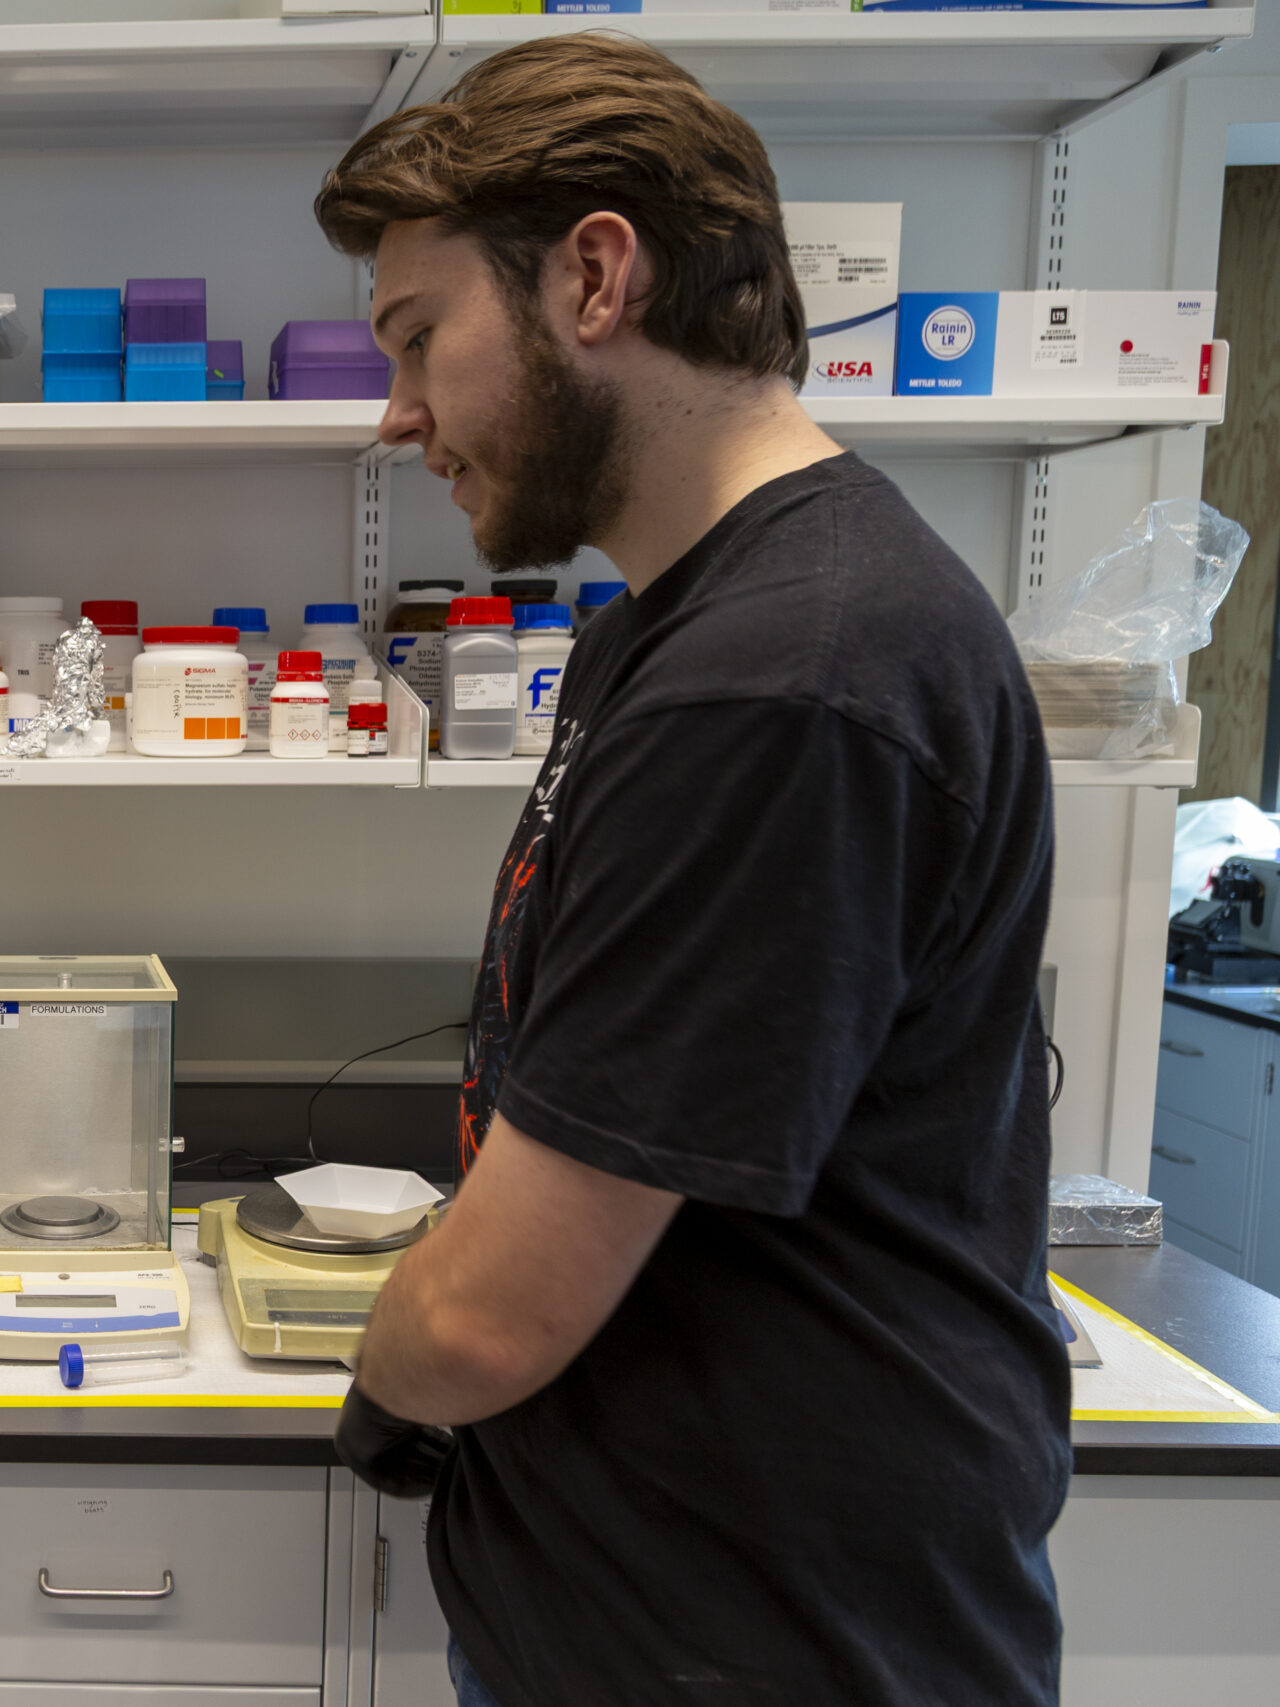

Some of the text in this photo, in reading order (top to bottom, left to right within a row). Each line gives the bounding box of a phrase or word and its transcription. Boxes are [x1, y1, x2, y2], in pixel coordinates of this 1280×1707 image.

[557, 4, 610, 12] METTLER TOLEDO
[1052, 311, 1066, 321] LTS
[931, 322, 967, 335] Rainin
[941, 336, 955, 346] LR
[827, 361, 873, 377] USA
[909, 378, 962, 388] METTLER TOLEDO
[31, 1005, 105, 1014] FORMULATIONS
